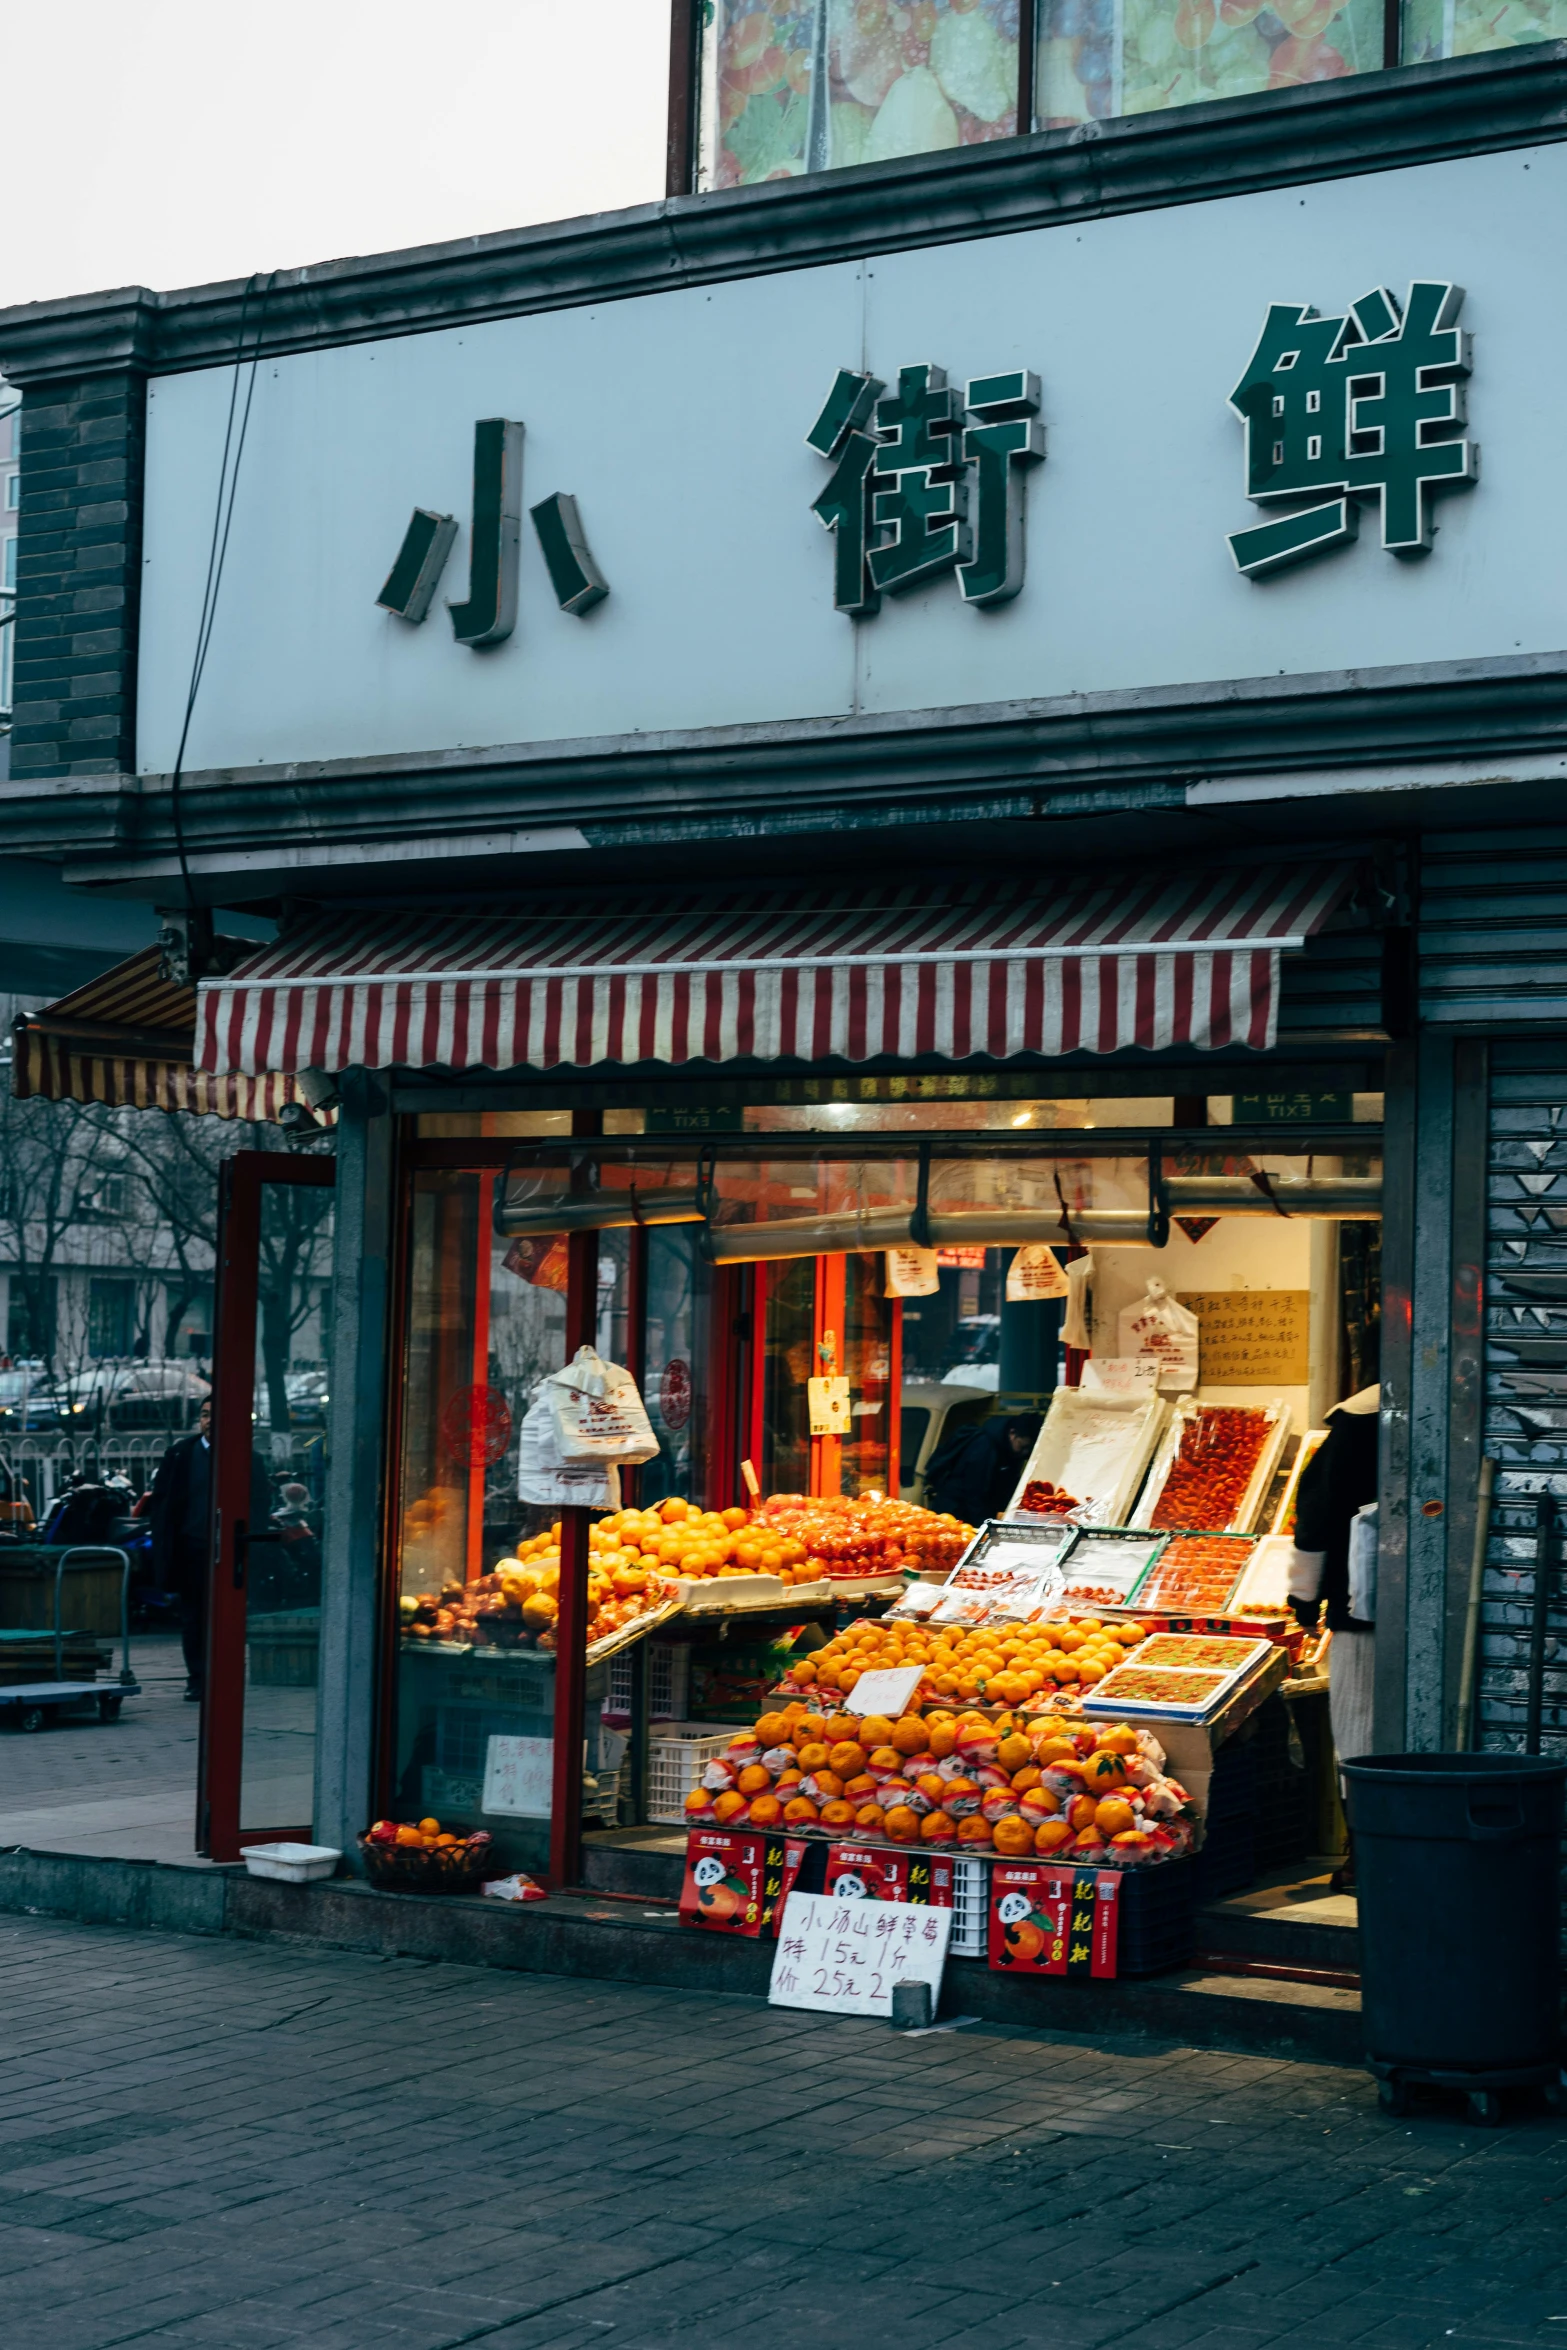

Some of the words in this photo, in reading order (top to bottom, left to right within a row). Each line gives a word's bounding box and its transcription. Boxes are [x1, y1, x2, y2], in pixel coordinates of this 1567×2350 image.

[376, 279, 1479, 648] 小街鲜
[800, 1901, 939, 1947] 小汤山鲜草莓
